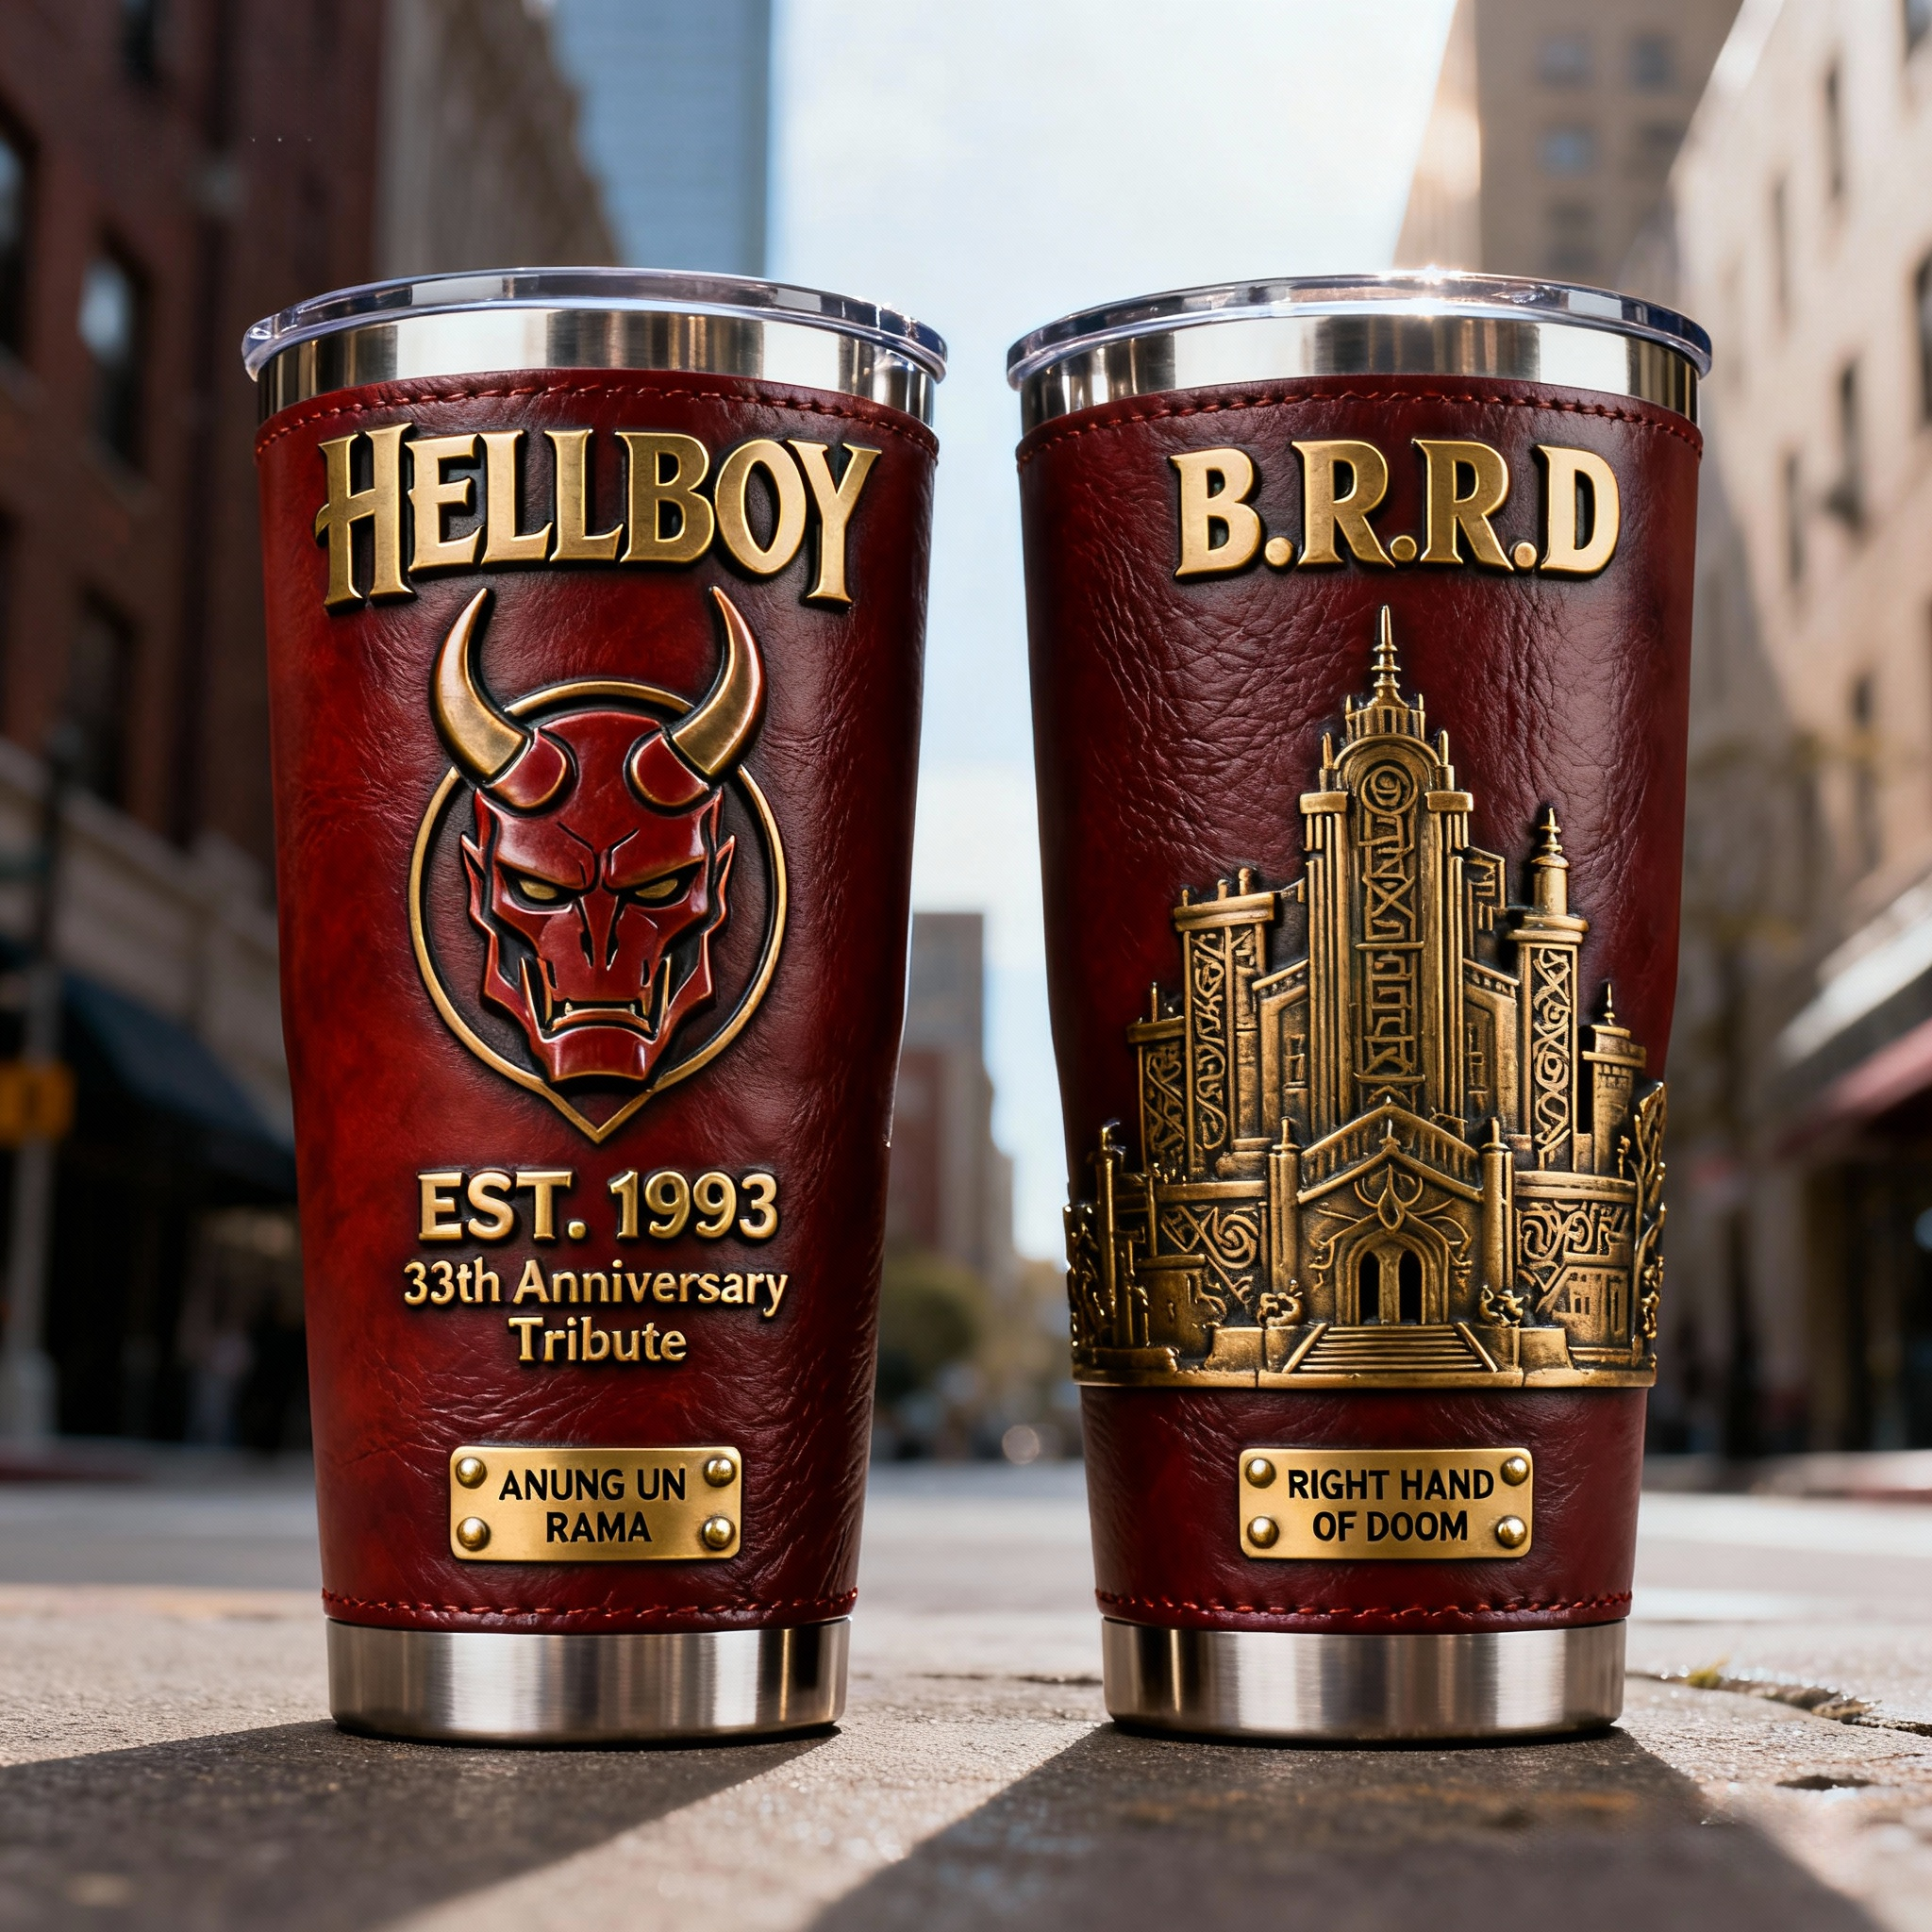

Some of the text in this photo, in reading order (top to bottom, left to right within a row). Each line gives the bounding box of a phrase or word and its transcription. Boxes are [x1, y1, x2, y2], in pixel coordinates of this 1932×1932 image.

[314, 422, 883, 610] HELLBOY
[1168, 438, 1621, 577] B.R.R.D
[417, 1170, 778, 1241] EST. 1993
[404, 1257, 789, 1317] 33th Anniversary
[508, 1316, 688, 1361] Tribute
[499, 1468, 686, 1501] ANUNG UN
[1288, 1469, 1494, 1500] RIGHT HAND
[546, 1511, 653, 1542] RAMA
[1313, 1510, 1468, 1541] OF DOOM
